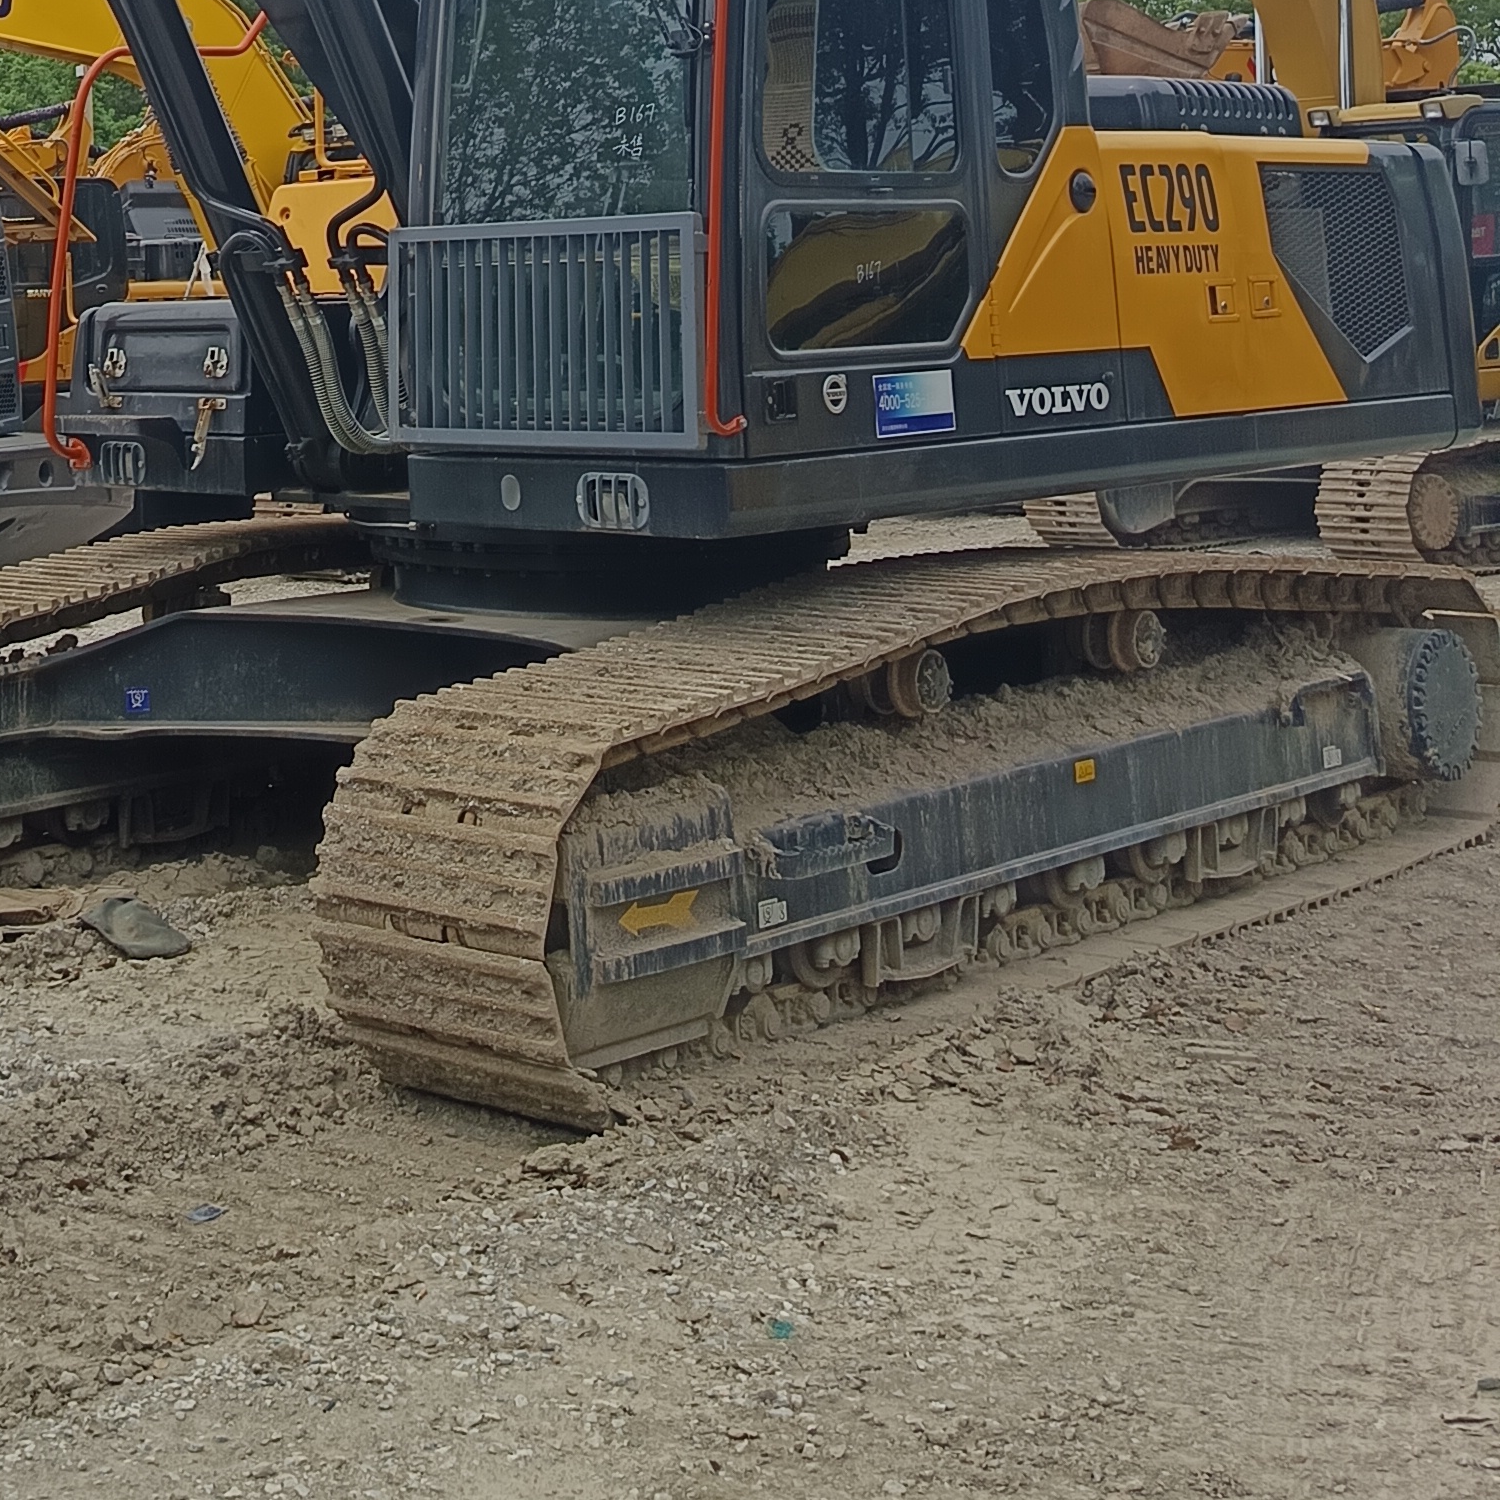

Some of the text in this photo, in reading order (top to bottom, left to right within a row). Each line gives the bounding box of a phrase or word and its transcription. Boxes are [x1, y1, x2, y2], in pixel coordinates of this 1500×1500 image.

[1119, 163, 1220, 233] EC290
[1134, 244, 1219, 275] HEAVY DUTY
[1005, 382, 1110, 417] VOLVO
